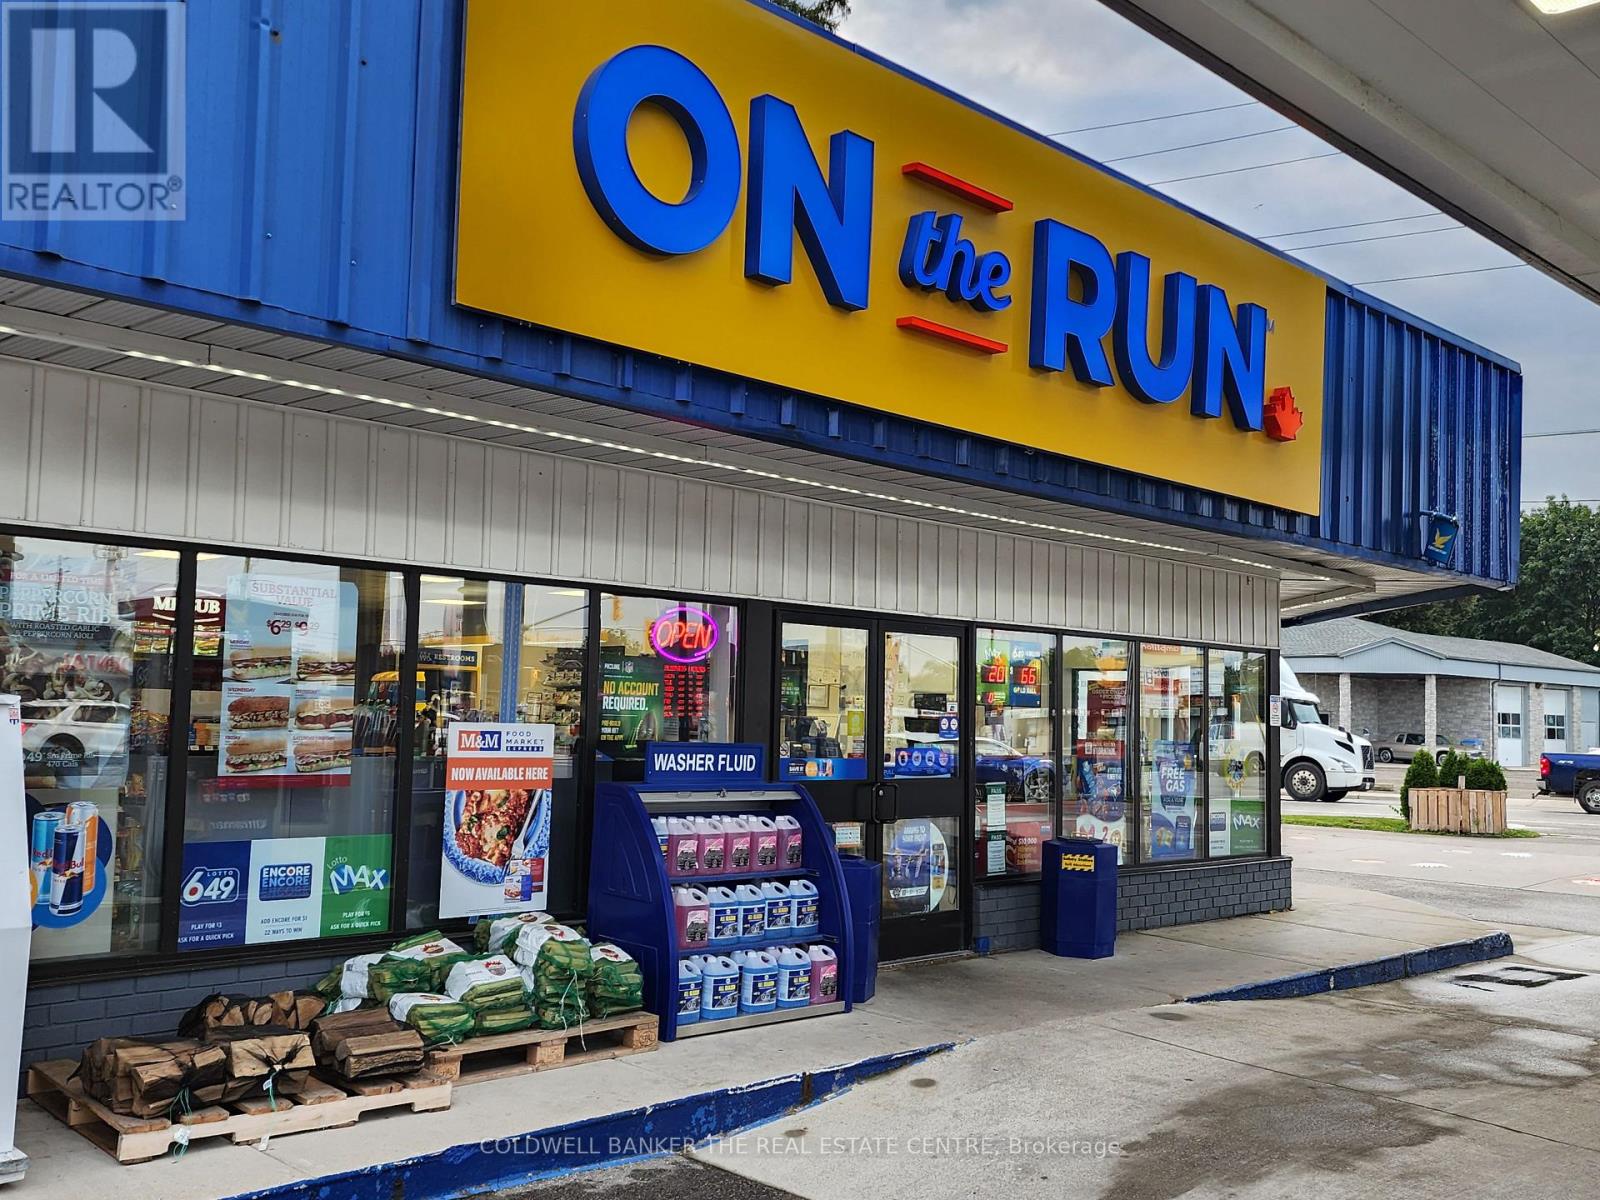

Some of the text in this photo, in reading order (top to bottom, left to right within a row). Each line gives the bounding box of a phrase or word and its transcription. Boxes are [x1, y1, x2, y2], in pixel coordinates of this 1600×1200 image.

[572, 43, 875, 313] ON
[898, 210, 1013, 312] the
[1029, 218, 1269, 433] RUN
[252, 582, 337, 600] SUBSTANTIAL
[76, 606, 111, 624] RIB
[11, 622, 32, 630] WITH
[34, 623, 70, 632] ROASTED
[656, 620, 712, 649] OPEN
[434, 653, 475, 661] RESTROOMS
[988, 665, 1004, 682] 20
[1021, 667, 1036, 684] 66
[603, 681, 660, 696] NO ACCOUNT
[602, 696, 649, 711] REQUIRED.
[460, 733, 499, 749] M&M
[654, 753, 756, 772] WASHER FLUID
[451, 767, 548, 781] NOW AVAILABLE HERE
[1161, 767, 1185, 780] FREE
[1166, 780, 1185, 792] GAS
[1233, 814, 1260, 830] MAX
[327, 856, 348, 870] Lotto
[262, 865, 311, 878] ENCORE
[330, 864, 387, 895] MAX
[183, 871, 235, 902] 649
[261, 876, 309, 888] ENCORE
[190, 923, 204, 931] PLAY
[330, 922, 340, 930] ASK
